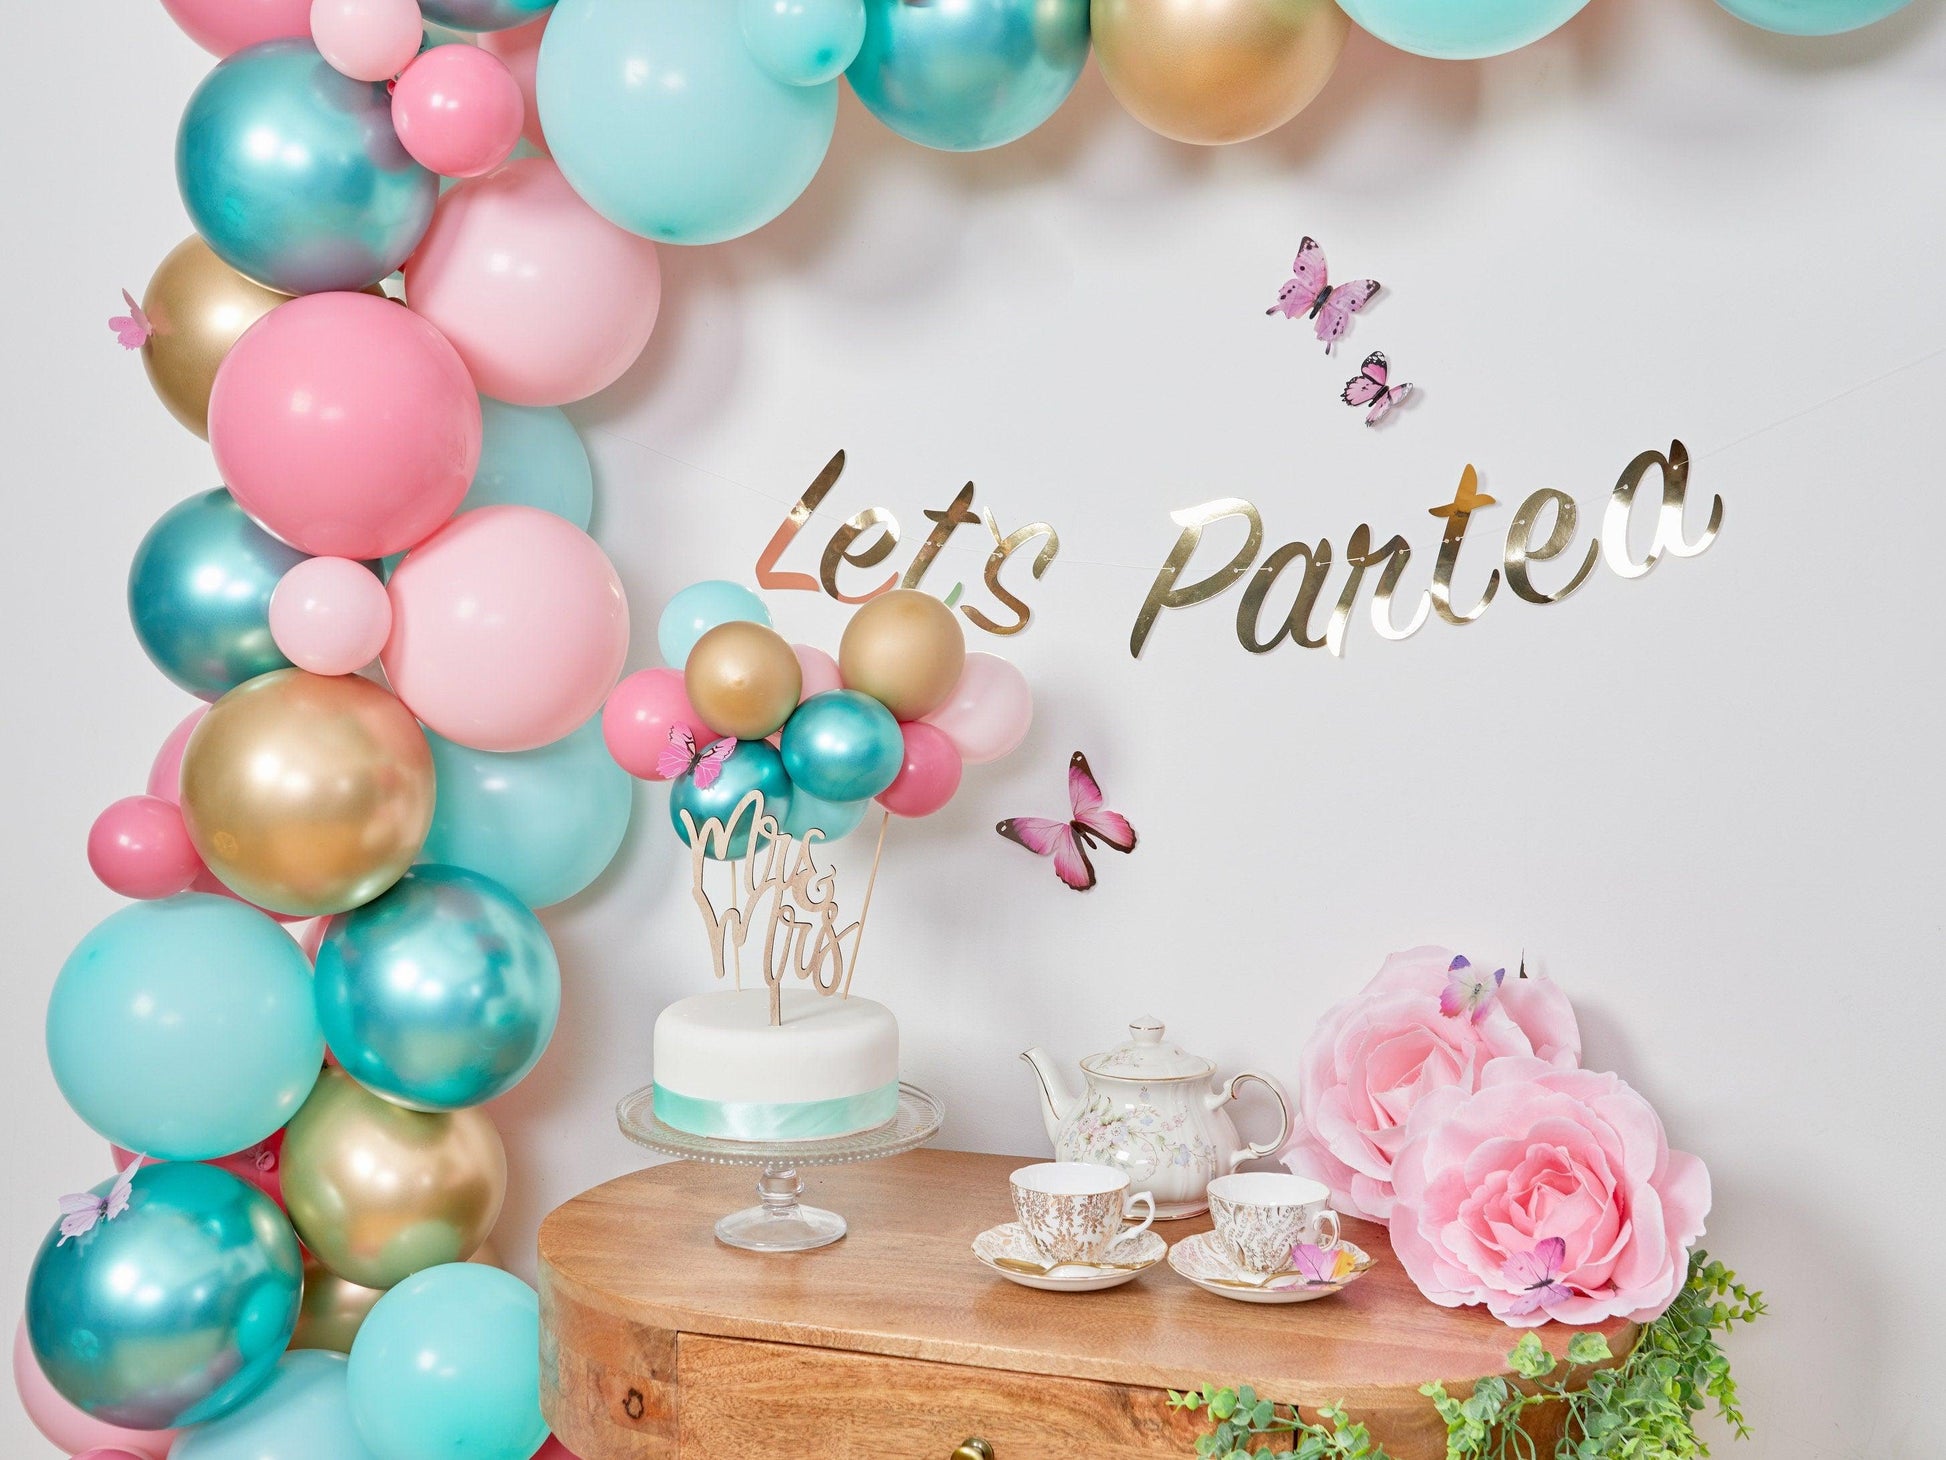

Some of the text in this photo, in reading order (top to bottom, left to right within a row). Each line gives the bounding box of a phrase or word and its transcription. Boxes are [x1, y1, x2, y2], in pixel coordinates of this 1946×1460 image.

[1129, 438, 1724, 659] Partea
[680, 789, 837, 912] Mr &
[692, 882, 860, 997] Mrs
